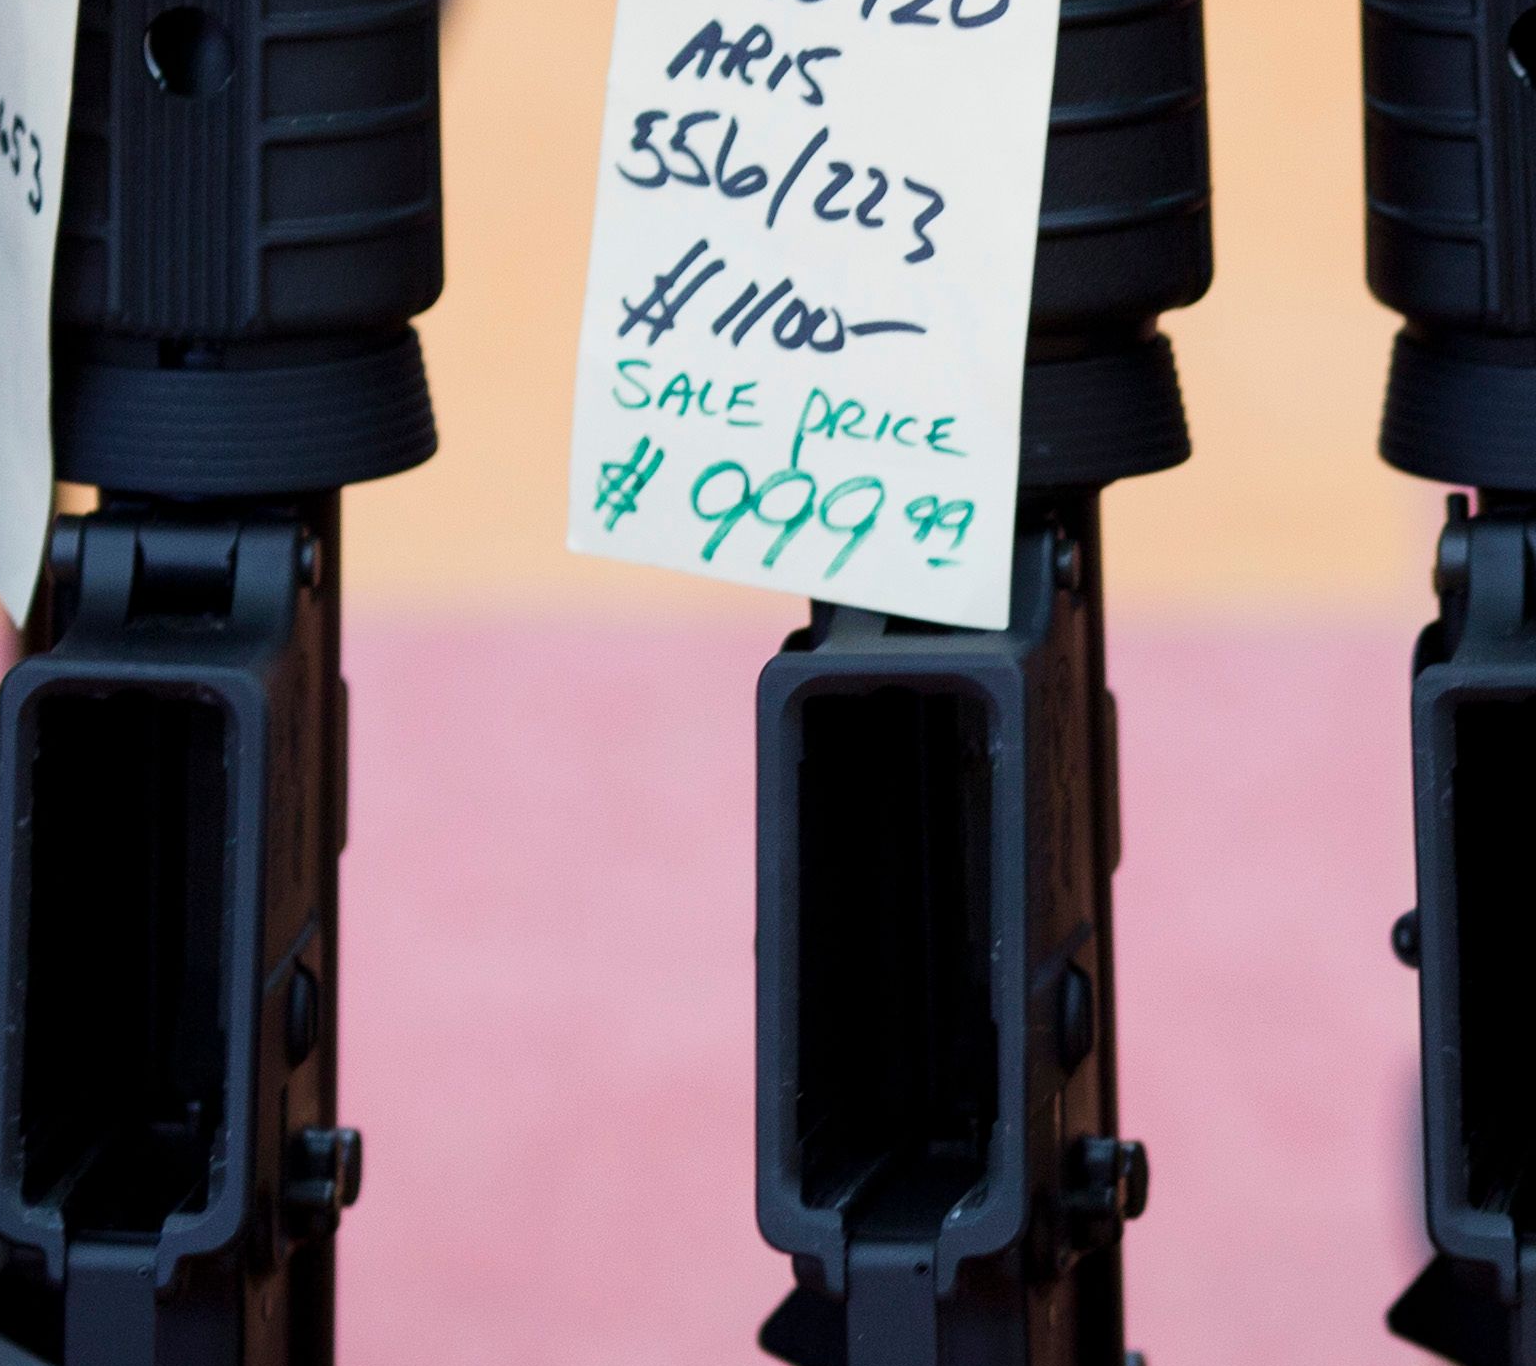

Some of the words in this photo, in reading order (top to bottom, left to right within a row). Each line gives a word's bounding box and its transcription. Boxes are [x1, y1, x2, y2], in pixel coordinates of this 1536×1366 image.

[666, 19, 842, 107] AR15
[615, 109, 946, 264] 556/223
[612, 358, 764, 428] SALE
[791, 385, 968, 471] PRICE
